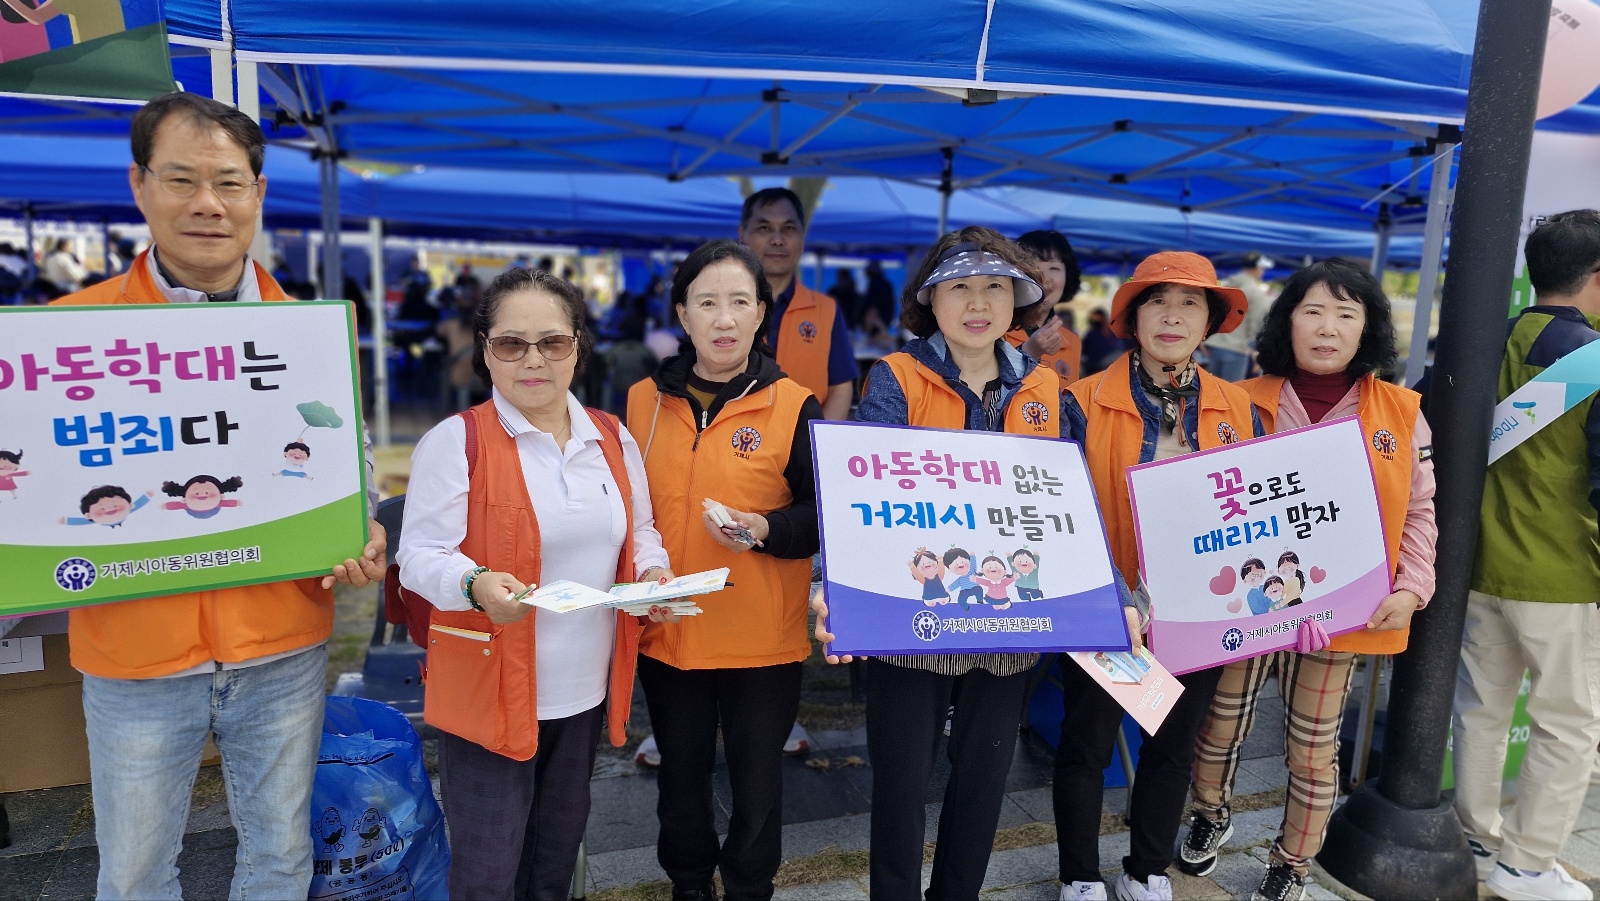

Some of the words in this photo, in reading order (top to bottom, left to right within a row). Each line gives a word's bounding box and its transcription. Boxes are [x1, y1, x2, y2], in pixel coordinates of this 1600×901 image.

[0, 339, 287, 401] 아동학대는
[53, 410, 239, 468] 범죄다
[847, 450, 1002, 490] 아동학대
[1012, 464, 1064, 496] 없는
[1207, 466, 1306, 522] 꽃으로도
[850, 501, 976, 530] 거제시
[987, 505, 1075, 541] 만들기
[1193, 515, 1279, 555] 때리지
[1286, 501, 1340, 540] 말자
[101, 547, 260, 578] 거제시아동위원협의회
[943, 617, 1052, 633] 거제시아동위원협의회
